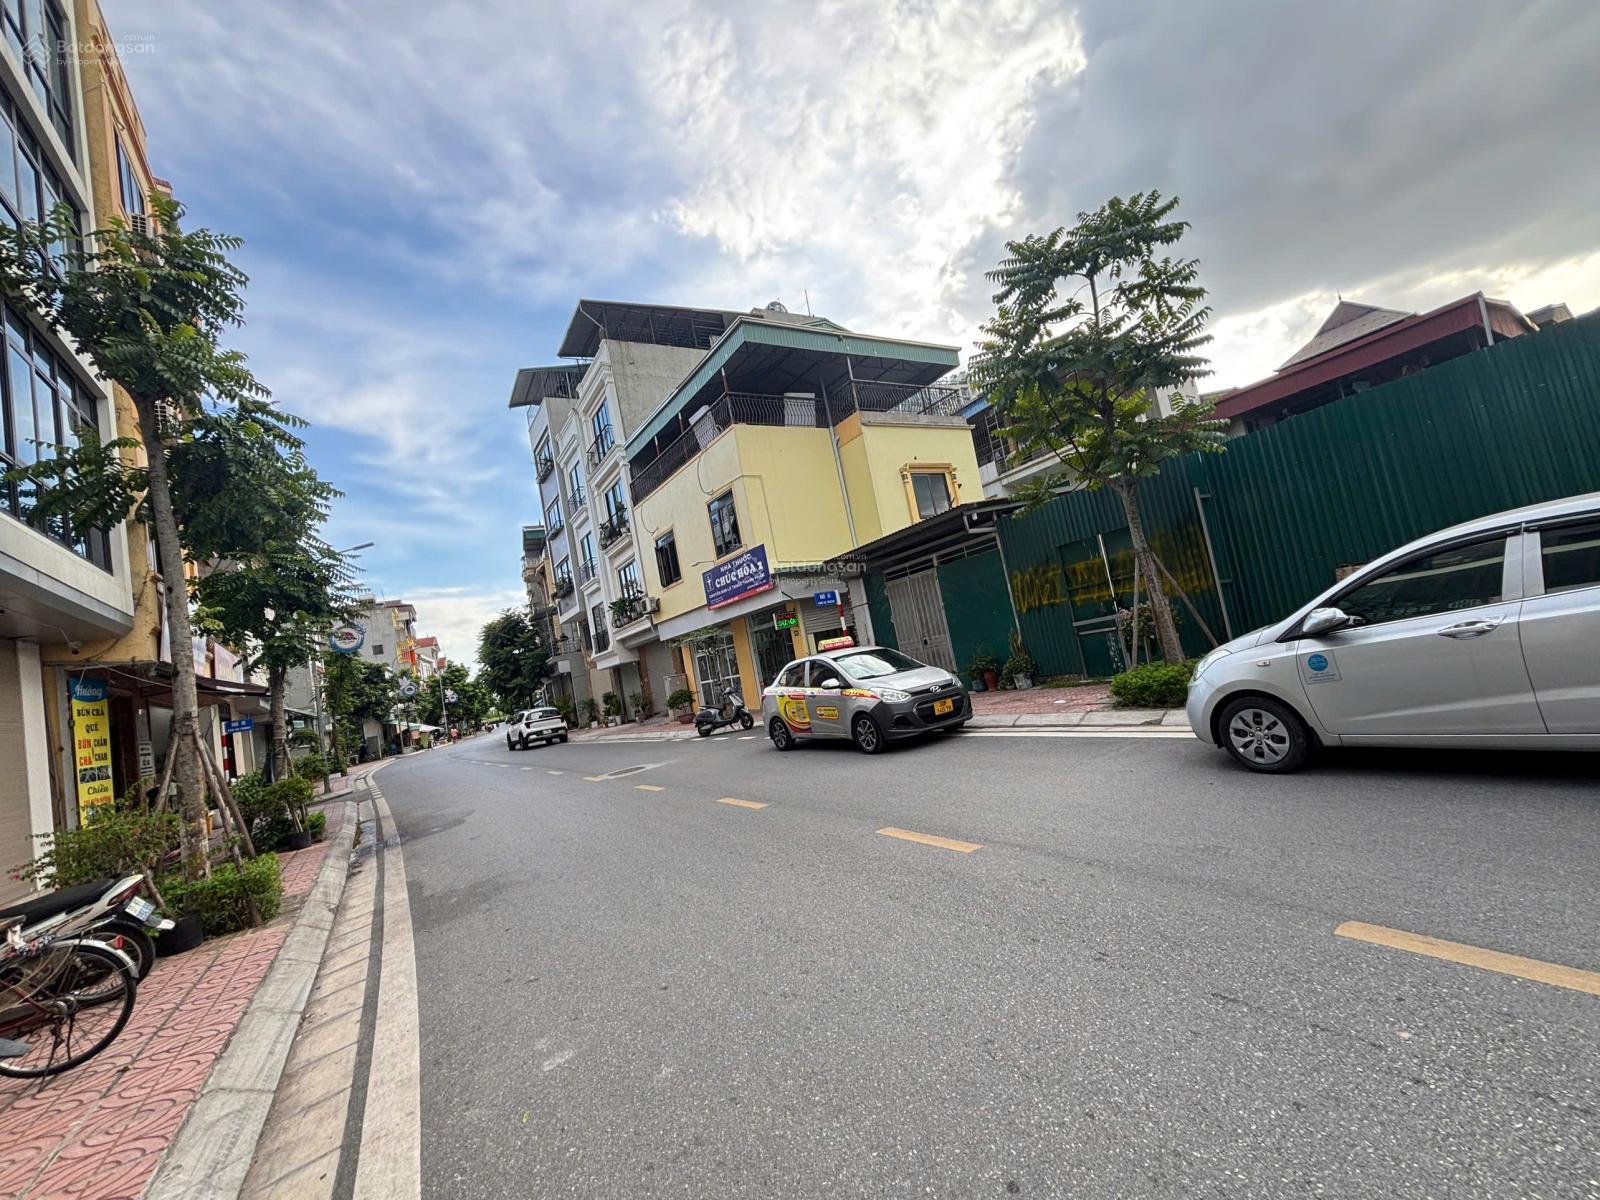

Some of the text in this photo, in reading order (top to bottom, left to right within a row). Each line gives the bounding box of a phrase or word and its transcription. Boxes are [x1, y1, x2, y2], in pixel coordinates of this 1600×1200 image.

[715, 571, 737, 588] CHÚC
[77, 704, 105, 717] BÚN CHẢ
[77, 738, 92, 749] BÚN
[79, 753, 93, 766] CHẢ
